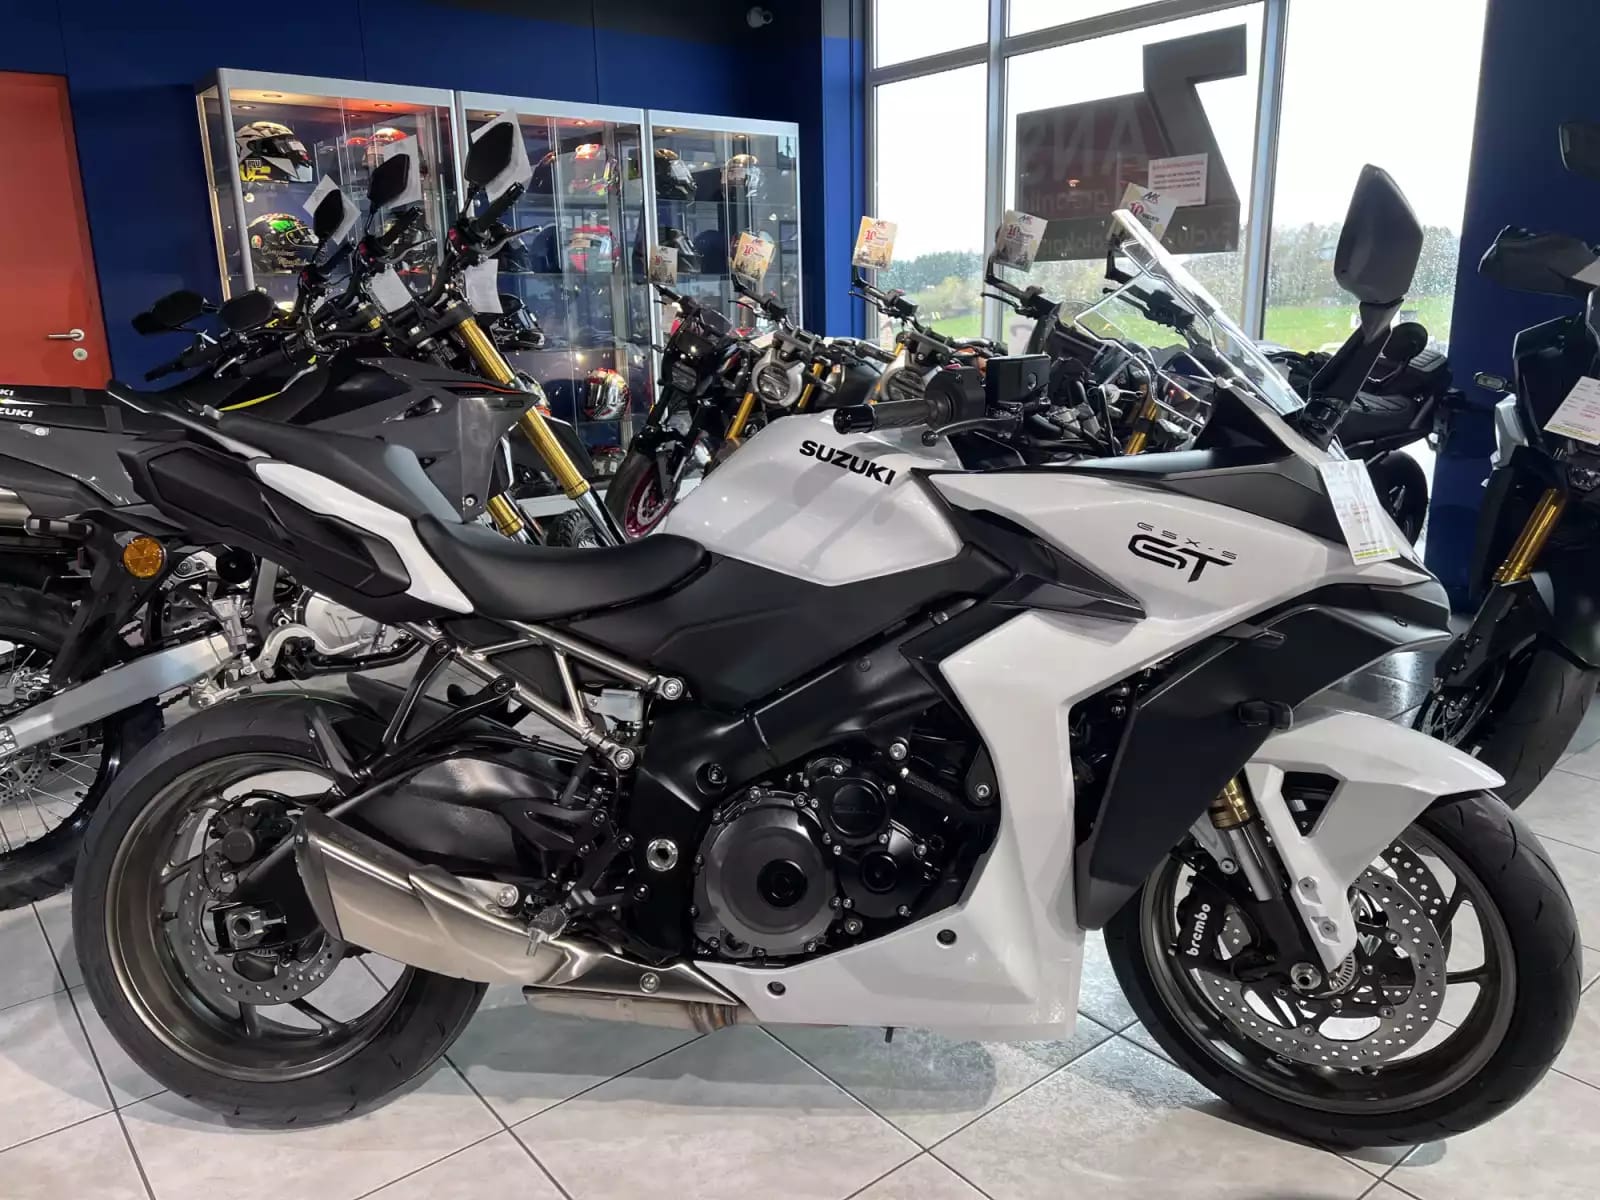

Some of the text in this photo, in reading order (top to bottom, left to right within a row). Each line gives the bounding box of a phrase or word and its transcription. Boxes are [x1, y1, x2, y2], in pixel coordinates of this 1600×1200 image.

[0, 388, 15, 396] KI
[799, 440, 897, 486] SUZUKI
[1127, 533, 1233, 583] GT
[1186, 903, 1211, 957] brembo
